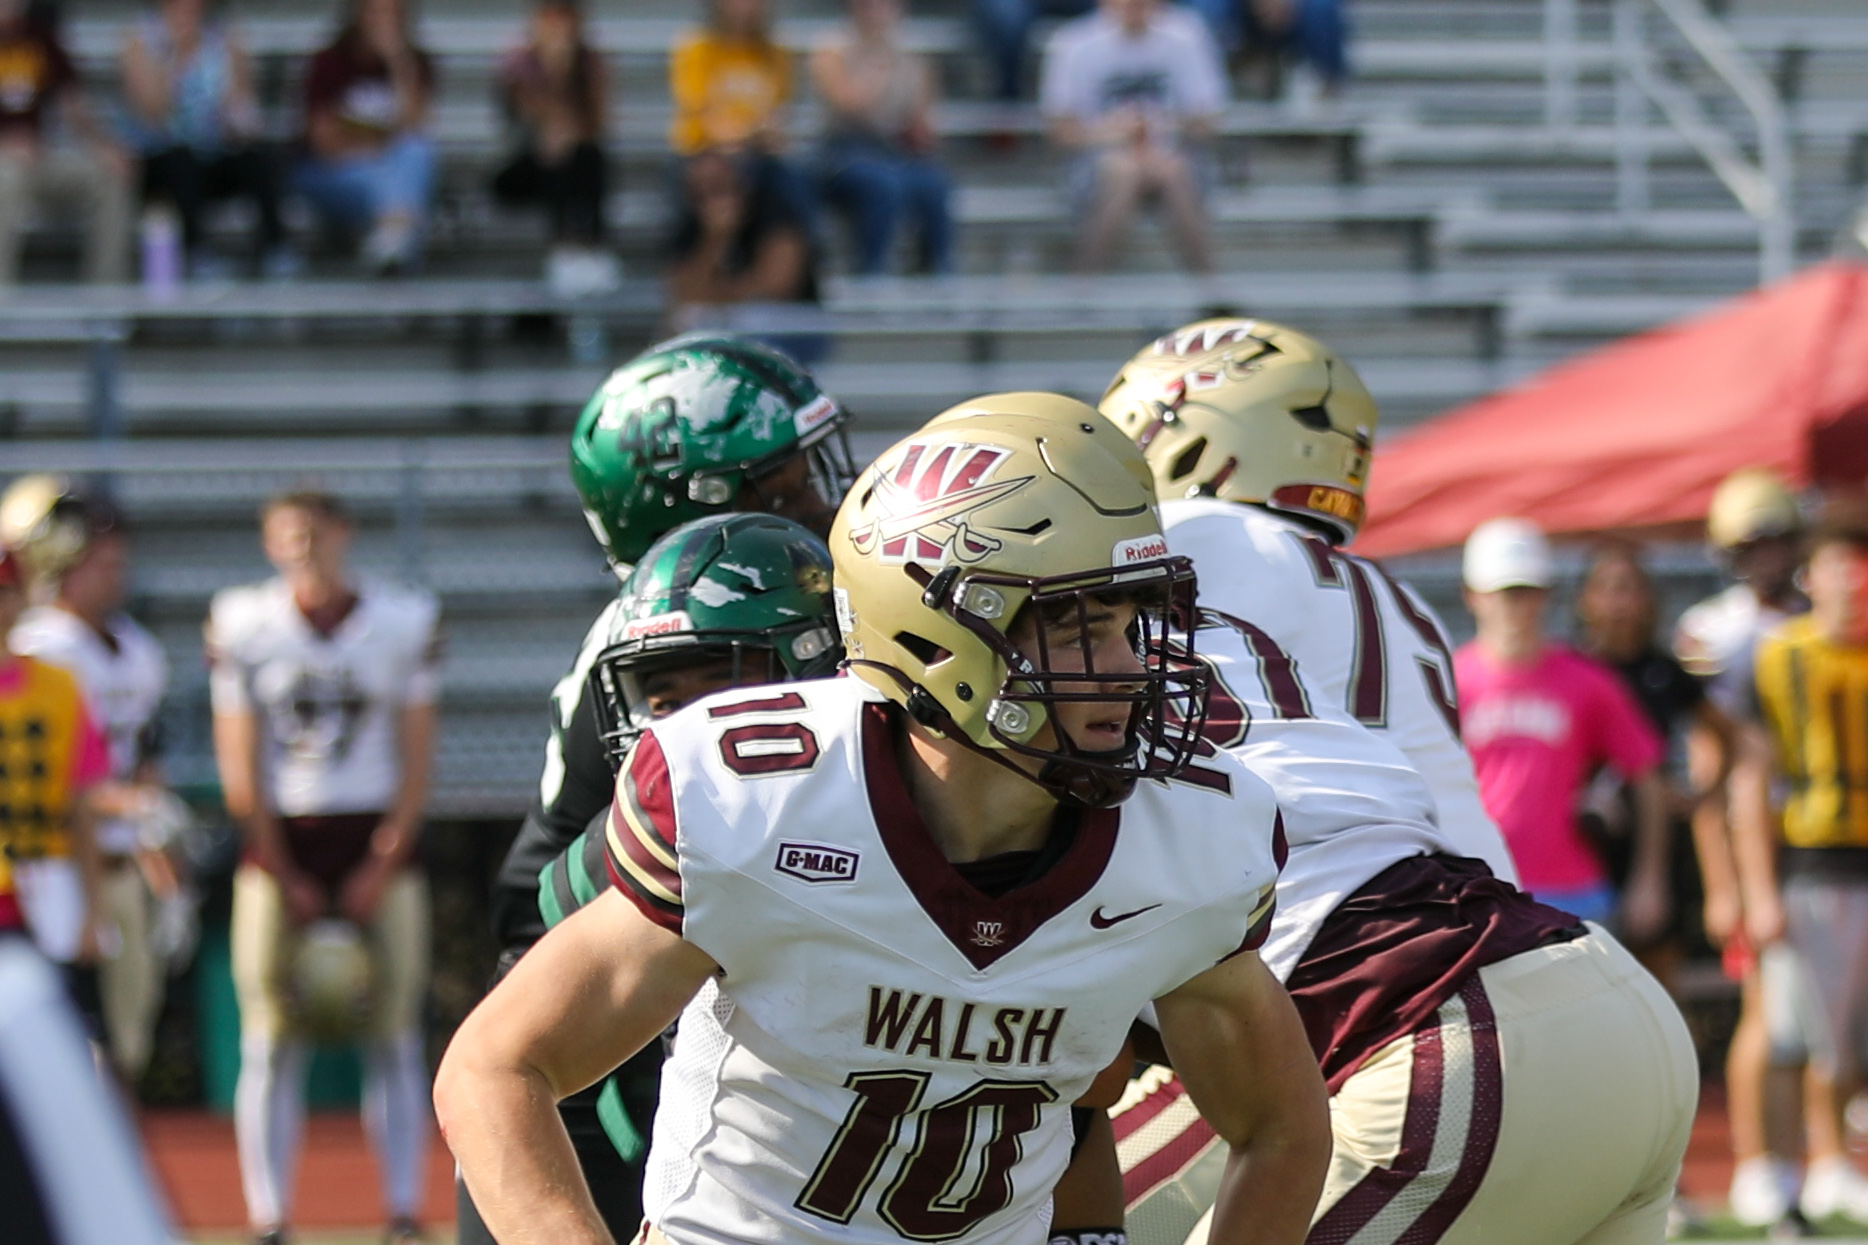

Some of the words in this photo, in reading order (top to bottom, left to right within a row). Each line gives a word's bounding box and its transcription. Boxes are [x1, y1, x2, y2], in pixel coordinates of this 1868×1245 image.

[704, 690, 825, 781] 10
[864, 986, 1067, 1066] WALSH
[794, 1070, 1059, 1242] 10
